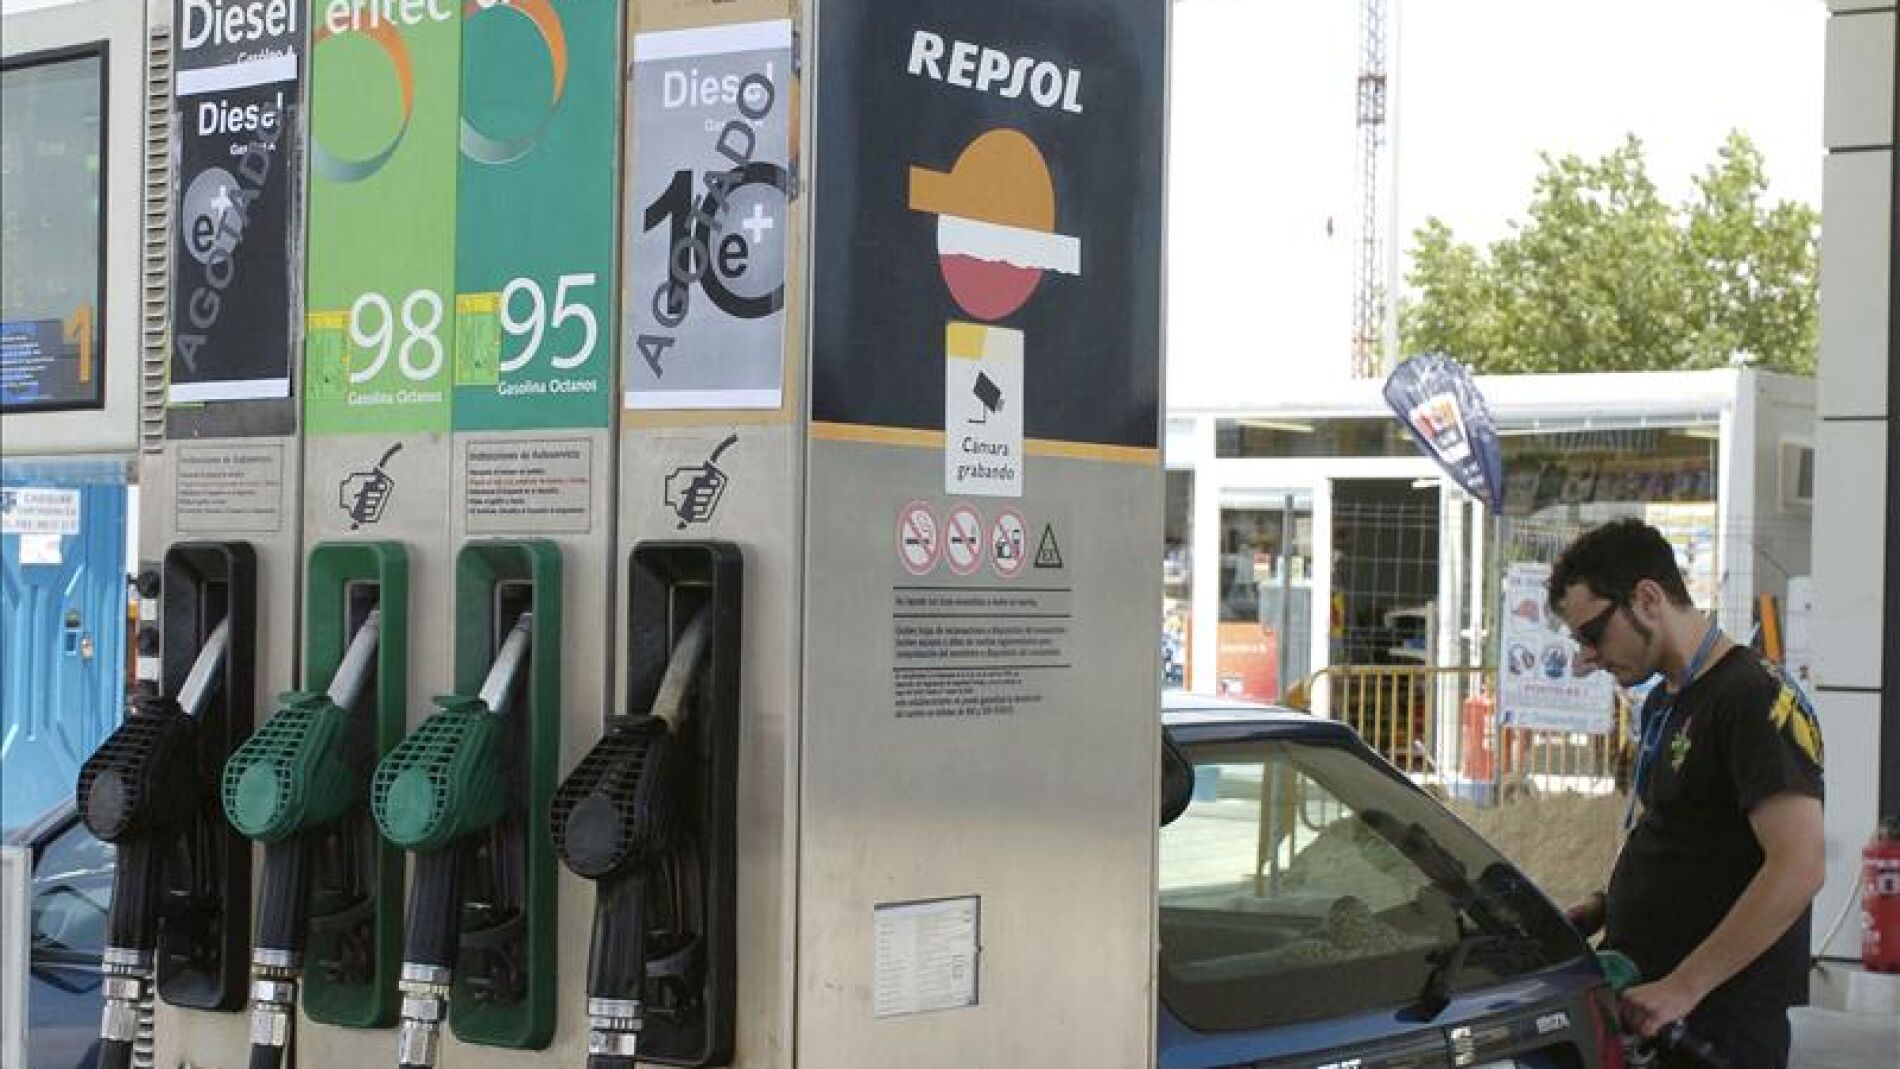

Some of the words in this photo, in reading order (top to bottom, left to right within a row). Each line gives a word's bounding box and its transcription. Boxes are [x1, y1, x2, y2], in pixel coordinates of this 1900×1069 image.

[181, 0, 296, 50] Diesel
[907, 30, 1084, 114] REPSOL
[637, 72, 775, 380] AGOTADO
[349, 289, 443, 383] 98
[499, 272, 598, 372] 95
[499, 381, 547, 396] Gasolina
[550, 379, 597, 394] Octanos
[956, 462, 1016, 482] grabando
